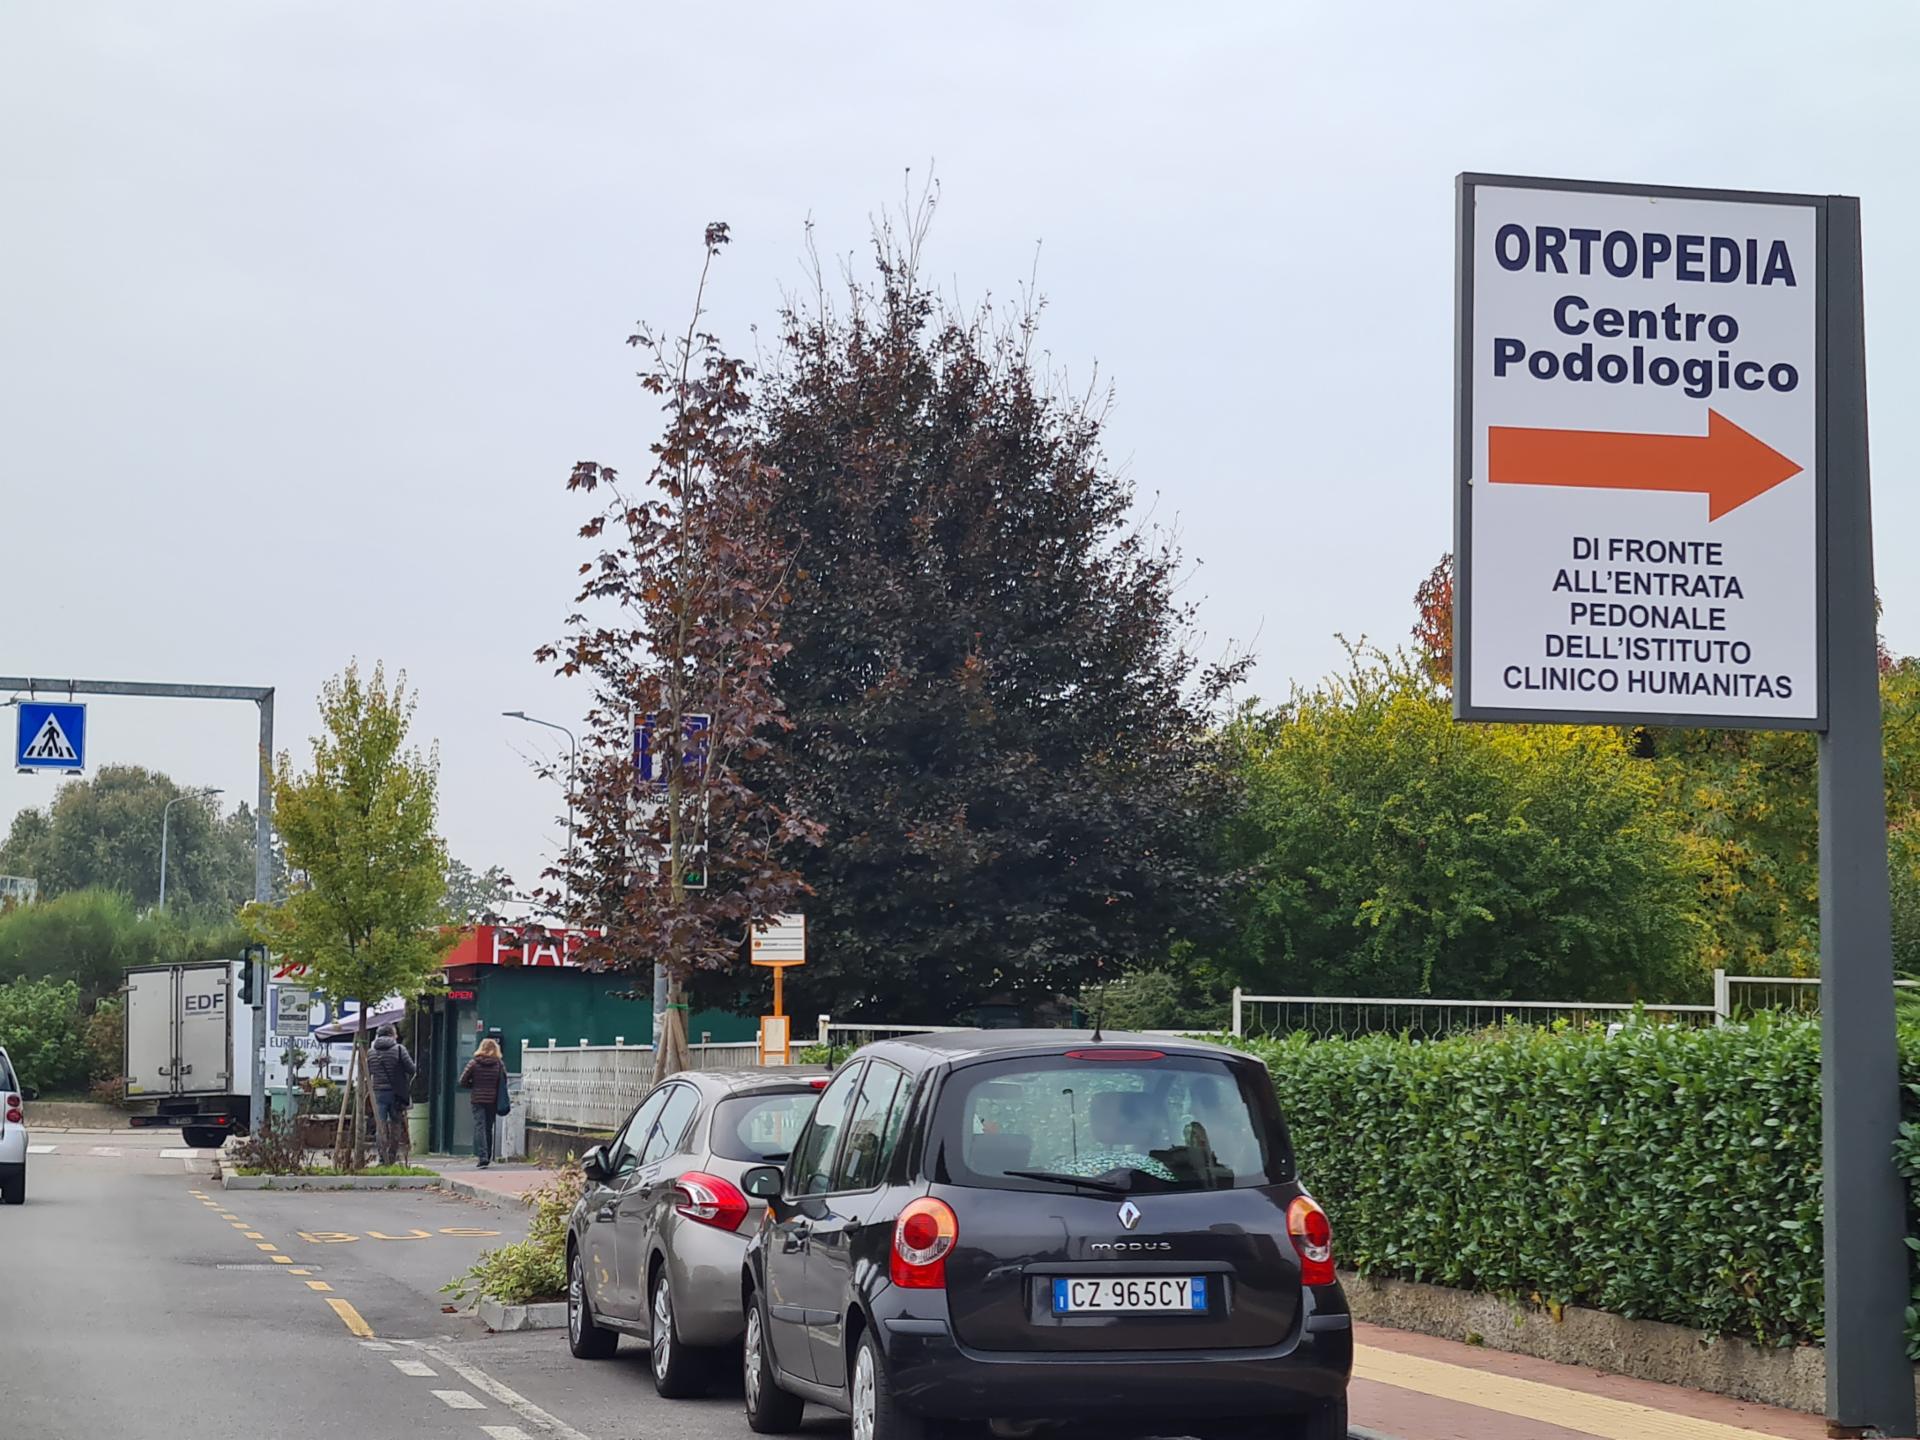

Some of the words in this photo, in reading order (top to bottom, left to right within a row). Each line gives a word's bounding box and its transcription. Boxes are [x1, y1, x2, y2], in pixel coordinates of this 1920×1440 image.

[1494, 223, 1798, 287] ORTOPEDIA
[1553, 295, 1740, 344] Centro
[1493, 337, 1799, 399] Podologico
[1573, 536, 1599, 561] DI
[1608, 537, 1723, 566] FRONTE
[1570, 602, 1726, 631] PEDONALE
[1503, 665, 1619, 693] CLINICO
[1628, 669, 1793, 700] HUMANITAS
[185, 993, 225, 1011] EDF
[448, 991, 473, 999] OPEN
[295, 1226, 503, 1244] BUS
[1091, 1242, 1172, 1251] MODUS
[1071, 1282, 1101, 1307] CZ
[1111, 1280, 1188, 1306] 965CY
